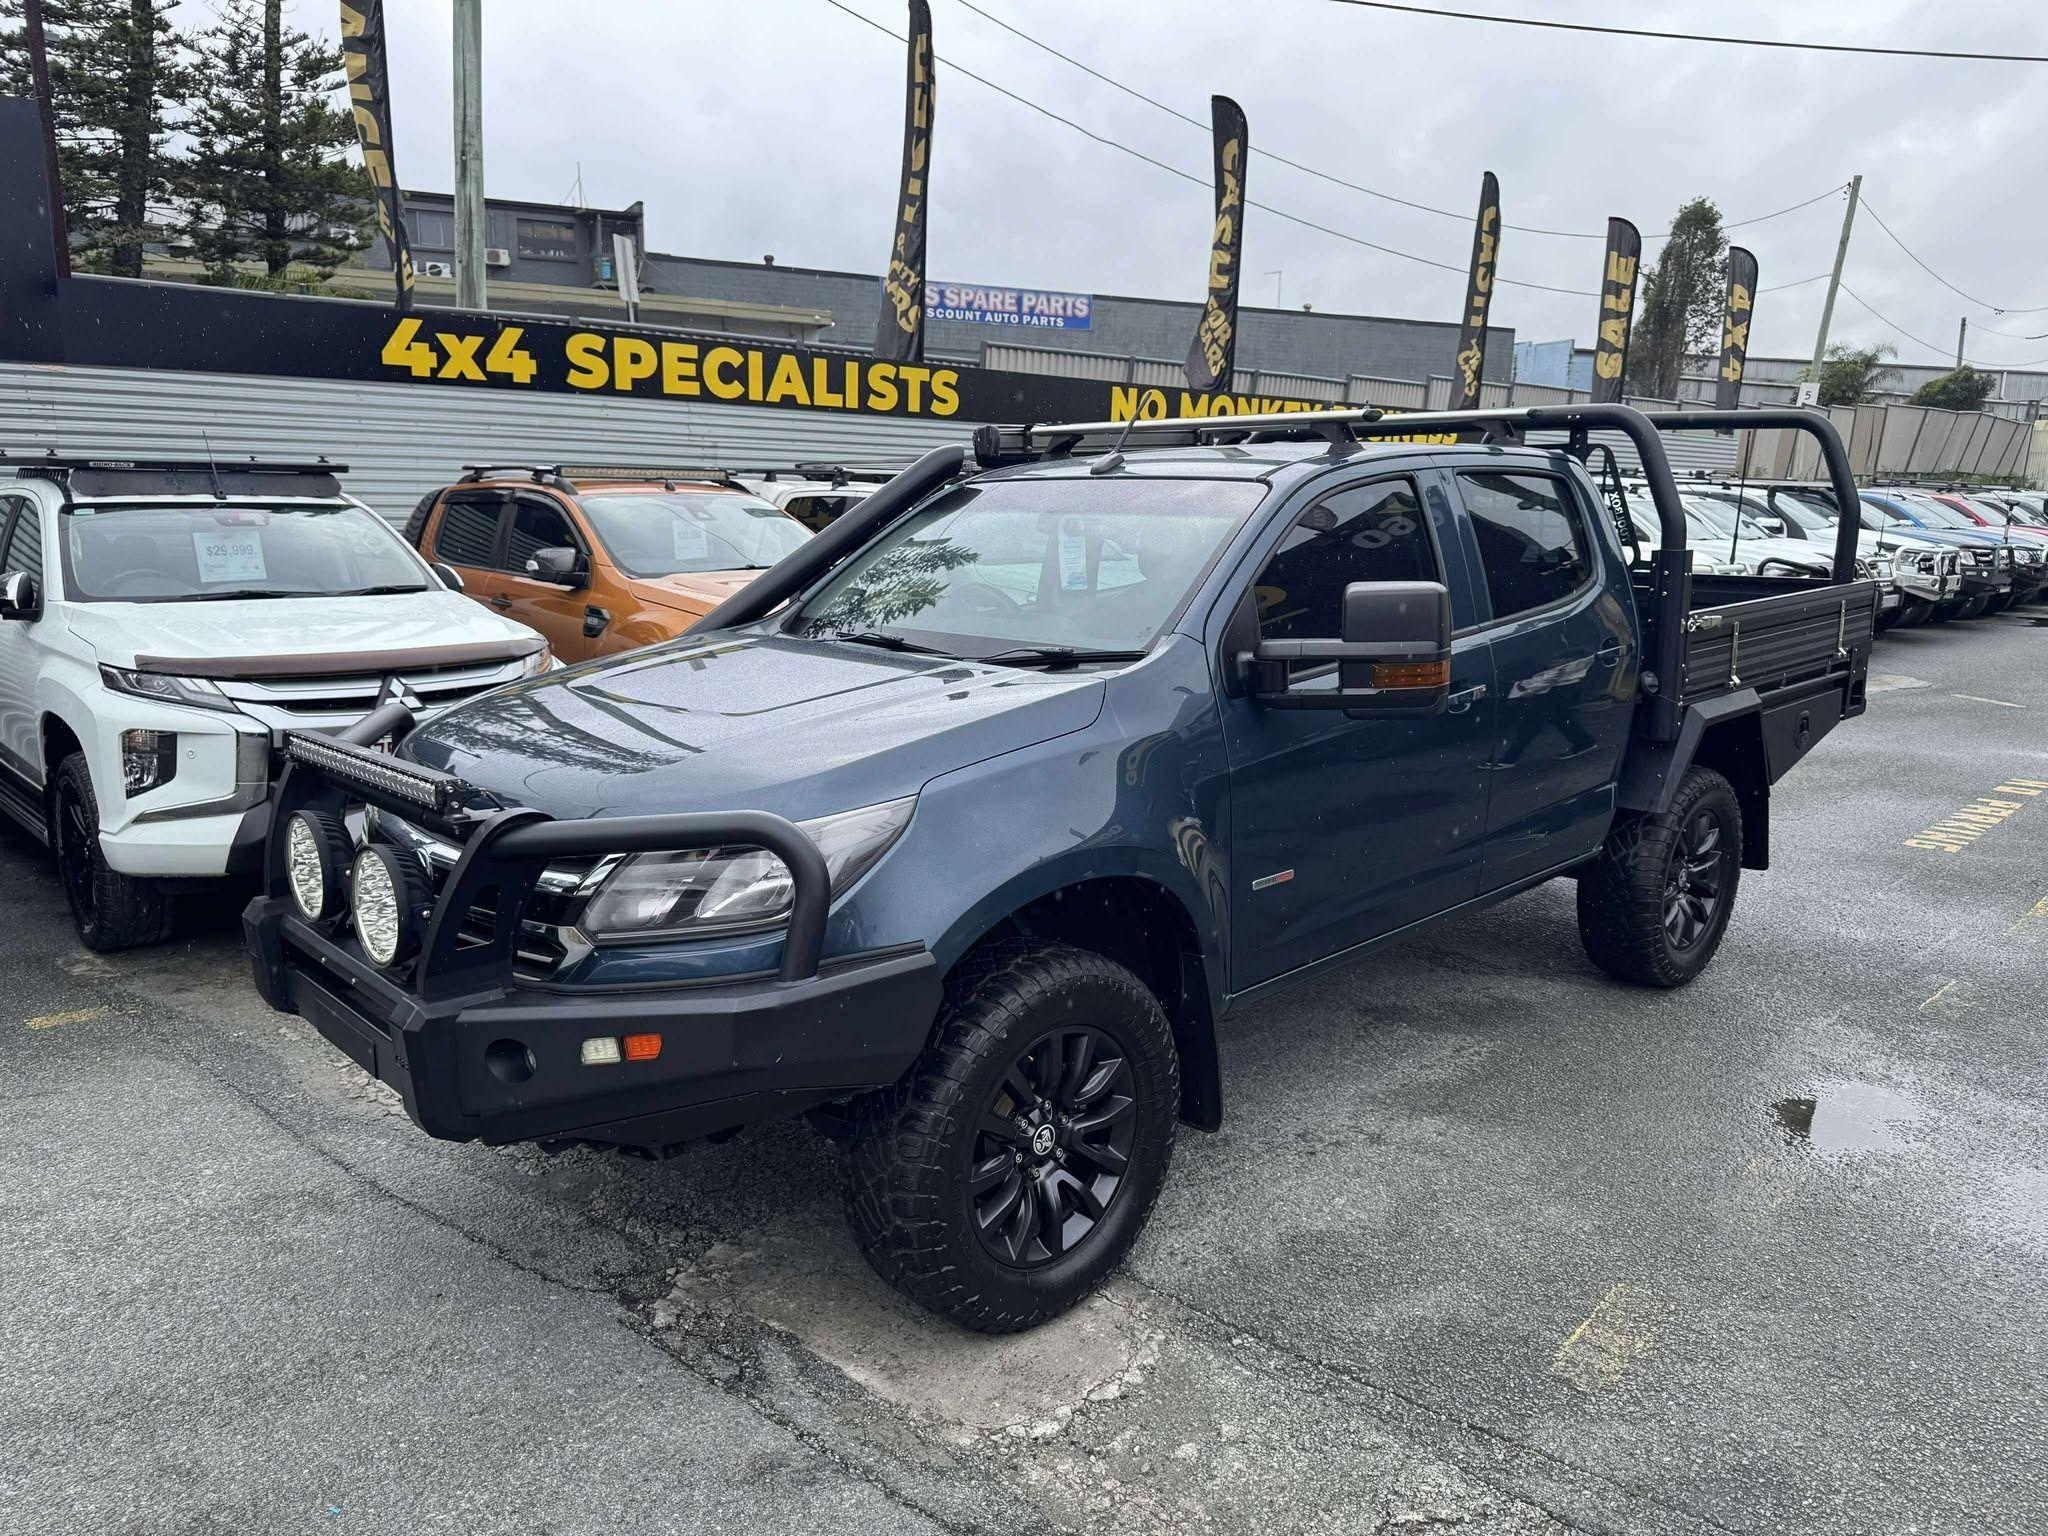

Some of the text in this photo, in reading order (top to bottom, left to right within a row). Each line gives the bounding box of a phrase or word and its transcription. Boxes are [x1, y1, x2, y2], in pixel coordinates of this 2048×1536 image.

[1208, 138, 1239, 289] CASH
[927, 308, 1064, 327] SCOUNT AUTO PARTS
[943, 286, 1018, 313] SPARE
[1022, 292, 1090, 318] PARTS
[1597, 250, 1635, 379] SALE
[381, 318, 961, 415] 4x4 SPECIALISTS
[1111, 386, 1168, 422] NO
[1804, 391, 1812, 400] 5
[1901, 798, 2025, 853] PARKING
